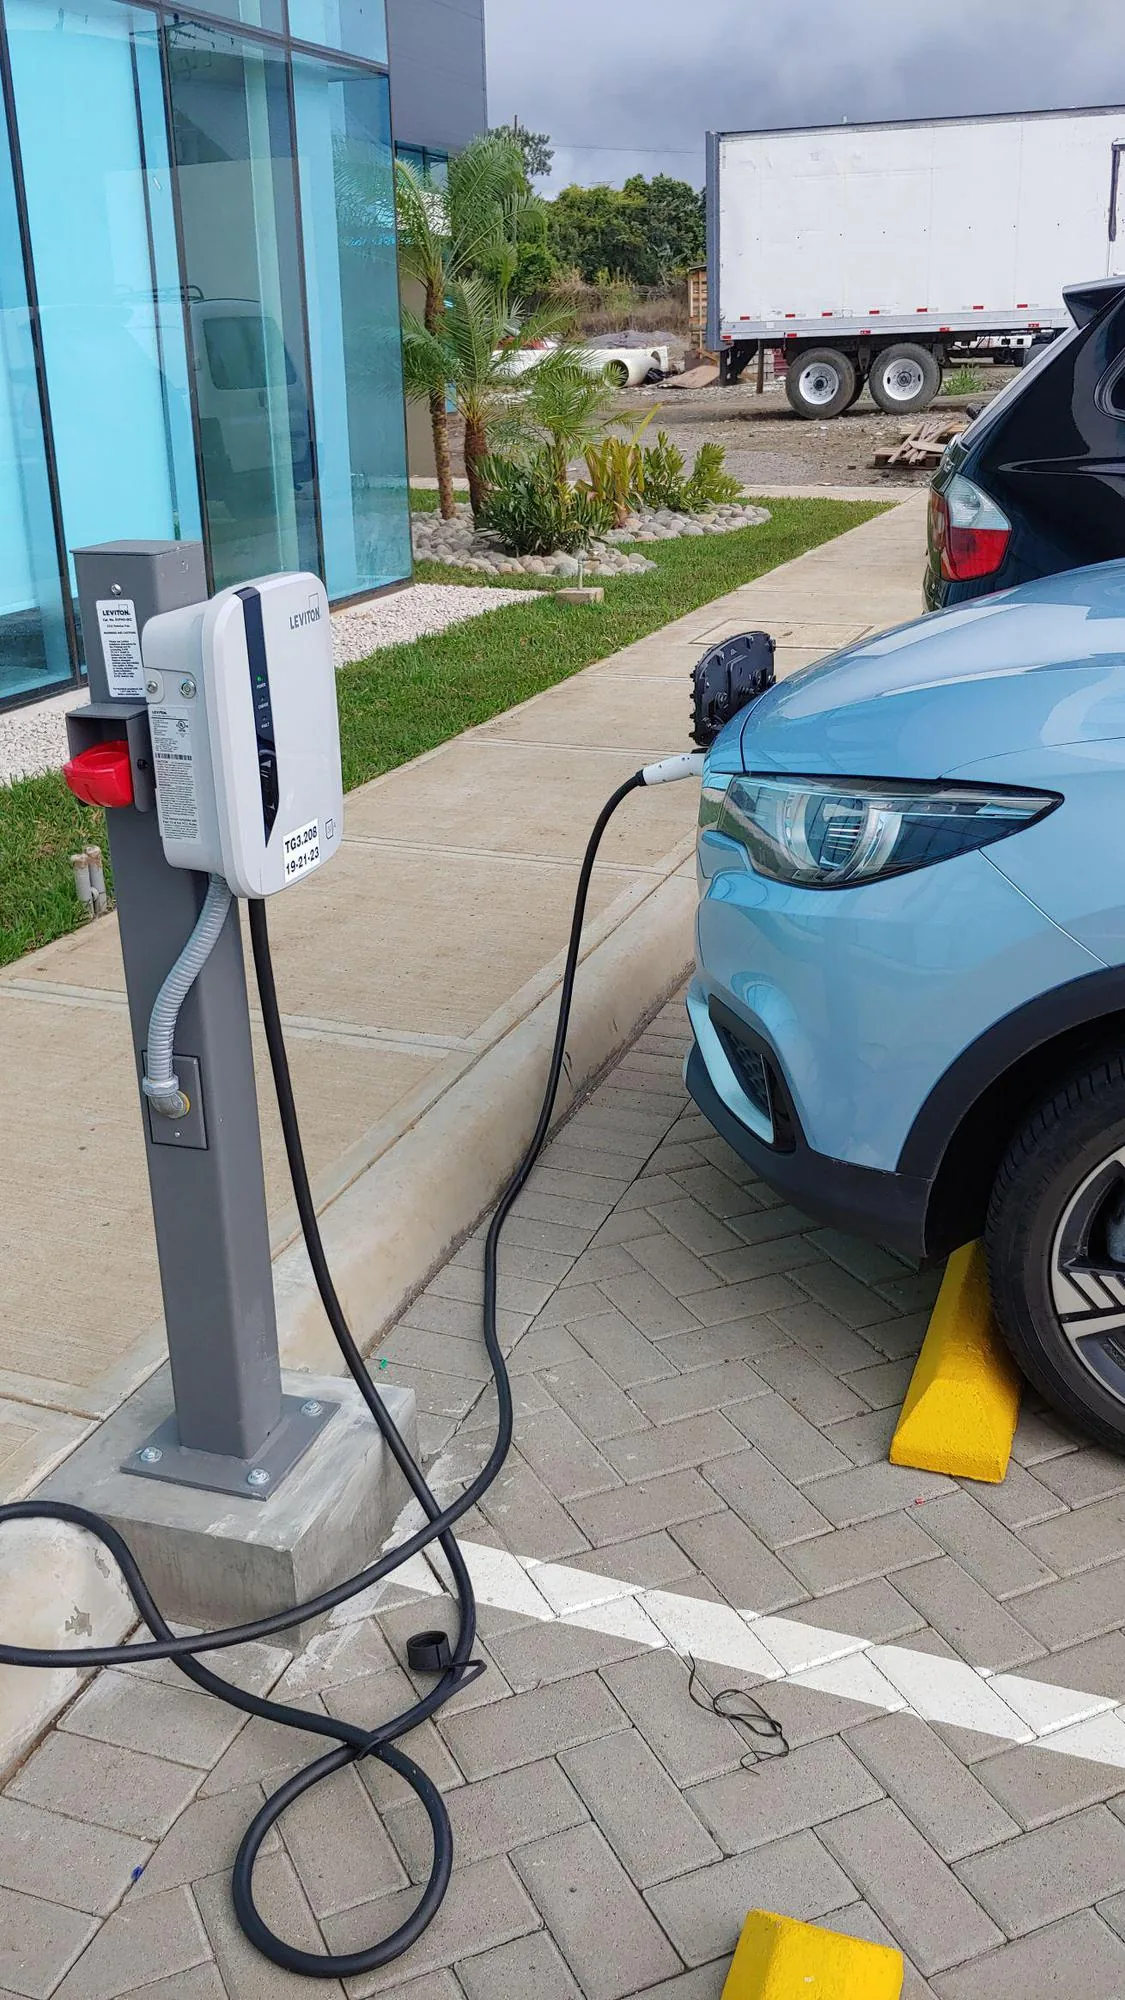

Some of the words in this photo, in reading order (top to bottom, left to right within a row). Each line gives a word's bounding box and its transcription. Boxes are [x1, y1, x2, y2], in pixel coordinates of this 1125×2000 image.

[290, 607, 321, 630] LEVITON
[284, 825, 318, 854] TG3.208
[286, 846, 320, 875] 19-21-23
